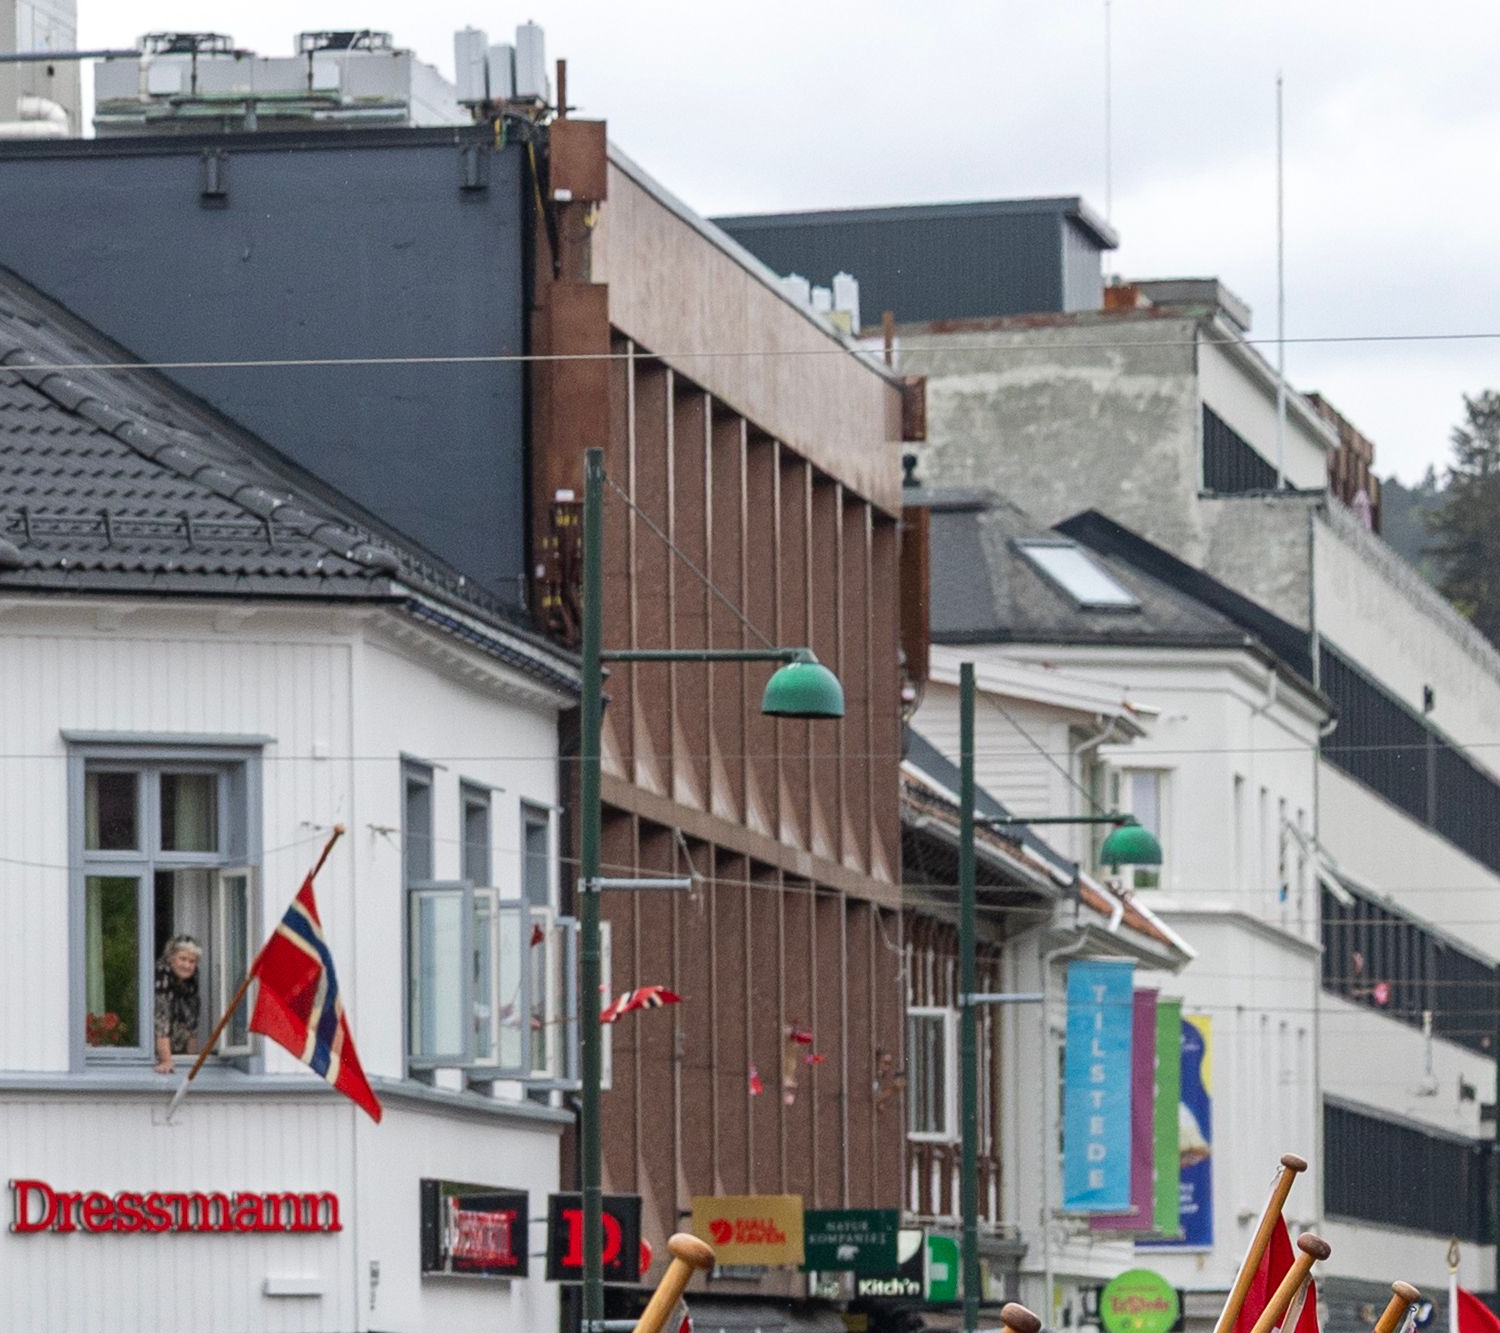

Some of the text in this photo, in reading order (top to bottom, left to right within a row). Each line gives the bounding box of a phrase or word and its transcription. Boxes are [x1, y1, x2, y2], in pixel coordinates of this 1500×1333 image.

[1087, 985, 1107, 1188] TILSTEDE
[9, 1178, 343, 1233] Dressmann
[859, 1278, 920, 1296] Kitch'n
